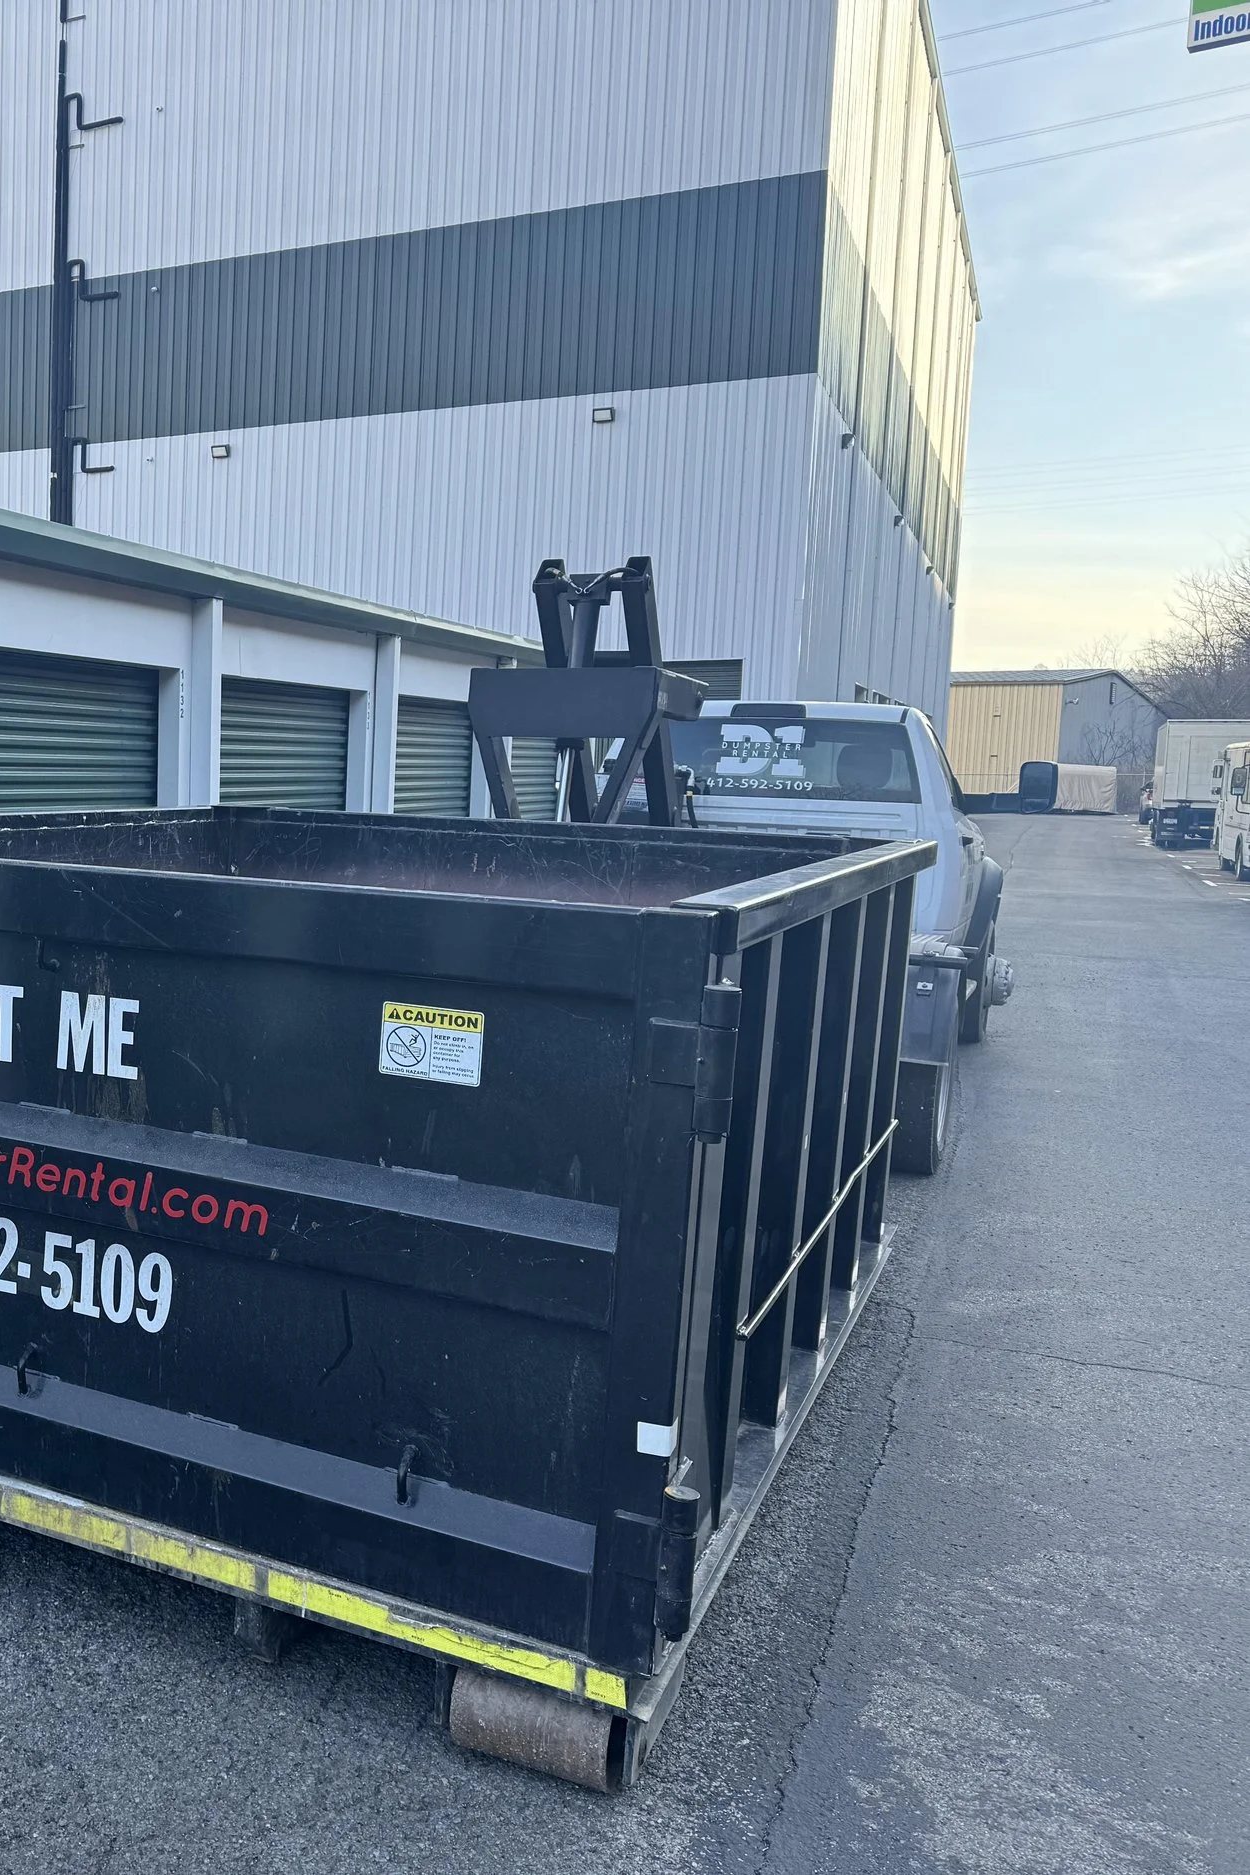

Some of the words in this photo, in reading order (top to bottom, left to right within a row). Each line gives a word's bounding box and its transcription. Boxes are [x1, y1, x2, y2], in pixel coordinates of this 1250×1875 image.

[716, 724, 806, 778] D1
[722, 742, 801, 751] DUMPSTER
[732, 749, 788, 759] RENTAL
[706, 778, 813, 791] 412-592-5109
[403, 1010, 478, 1029] CAUTION
[56, 990, 140, 1080] ME
[382, 1065, 404, 1073] FALLING
[406, 1068, 428, 1076] HAZARD
